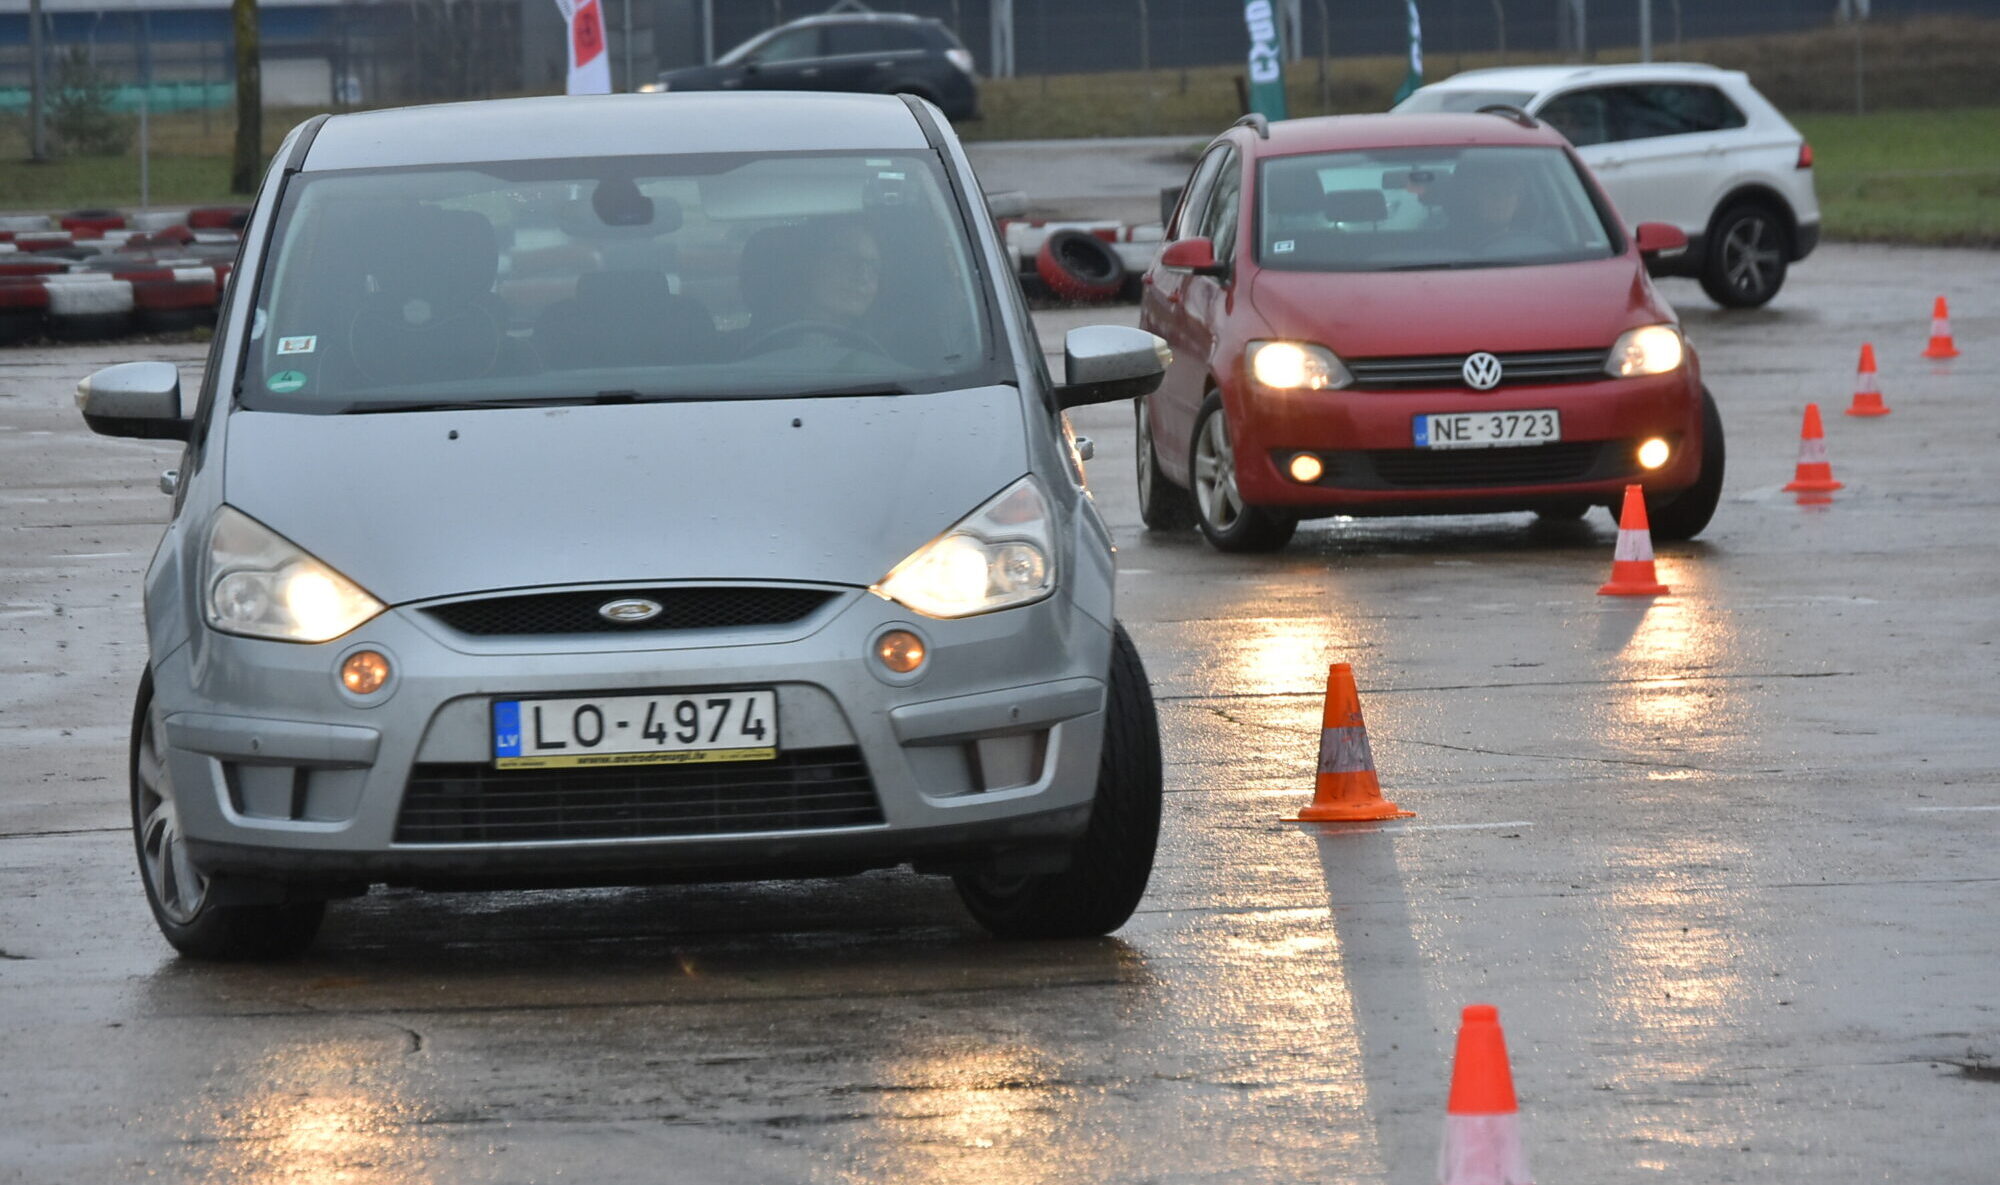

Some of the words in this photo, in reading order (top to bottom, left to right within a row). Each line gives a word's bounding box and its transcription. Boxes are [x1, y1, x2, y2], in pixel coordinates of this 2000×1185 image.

[1434, 414, 1553, 441] NE-3723
[534, 697, 765, 750] LO-4974
[498, 734, 518, 747] LV
